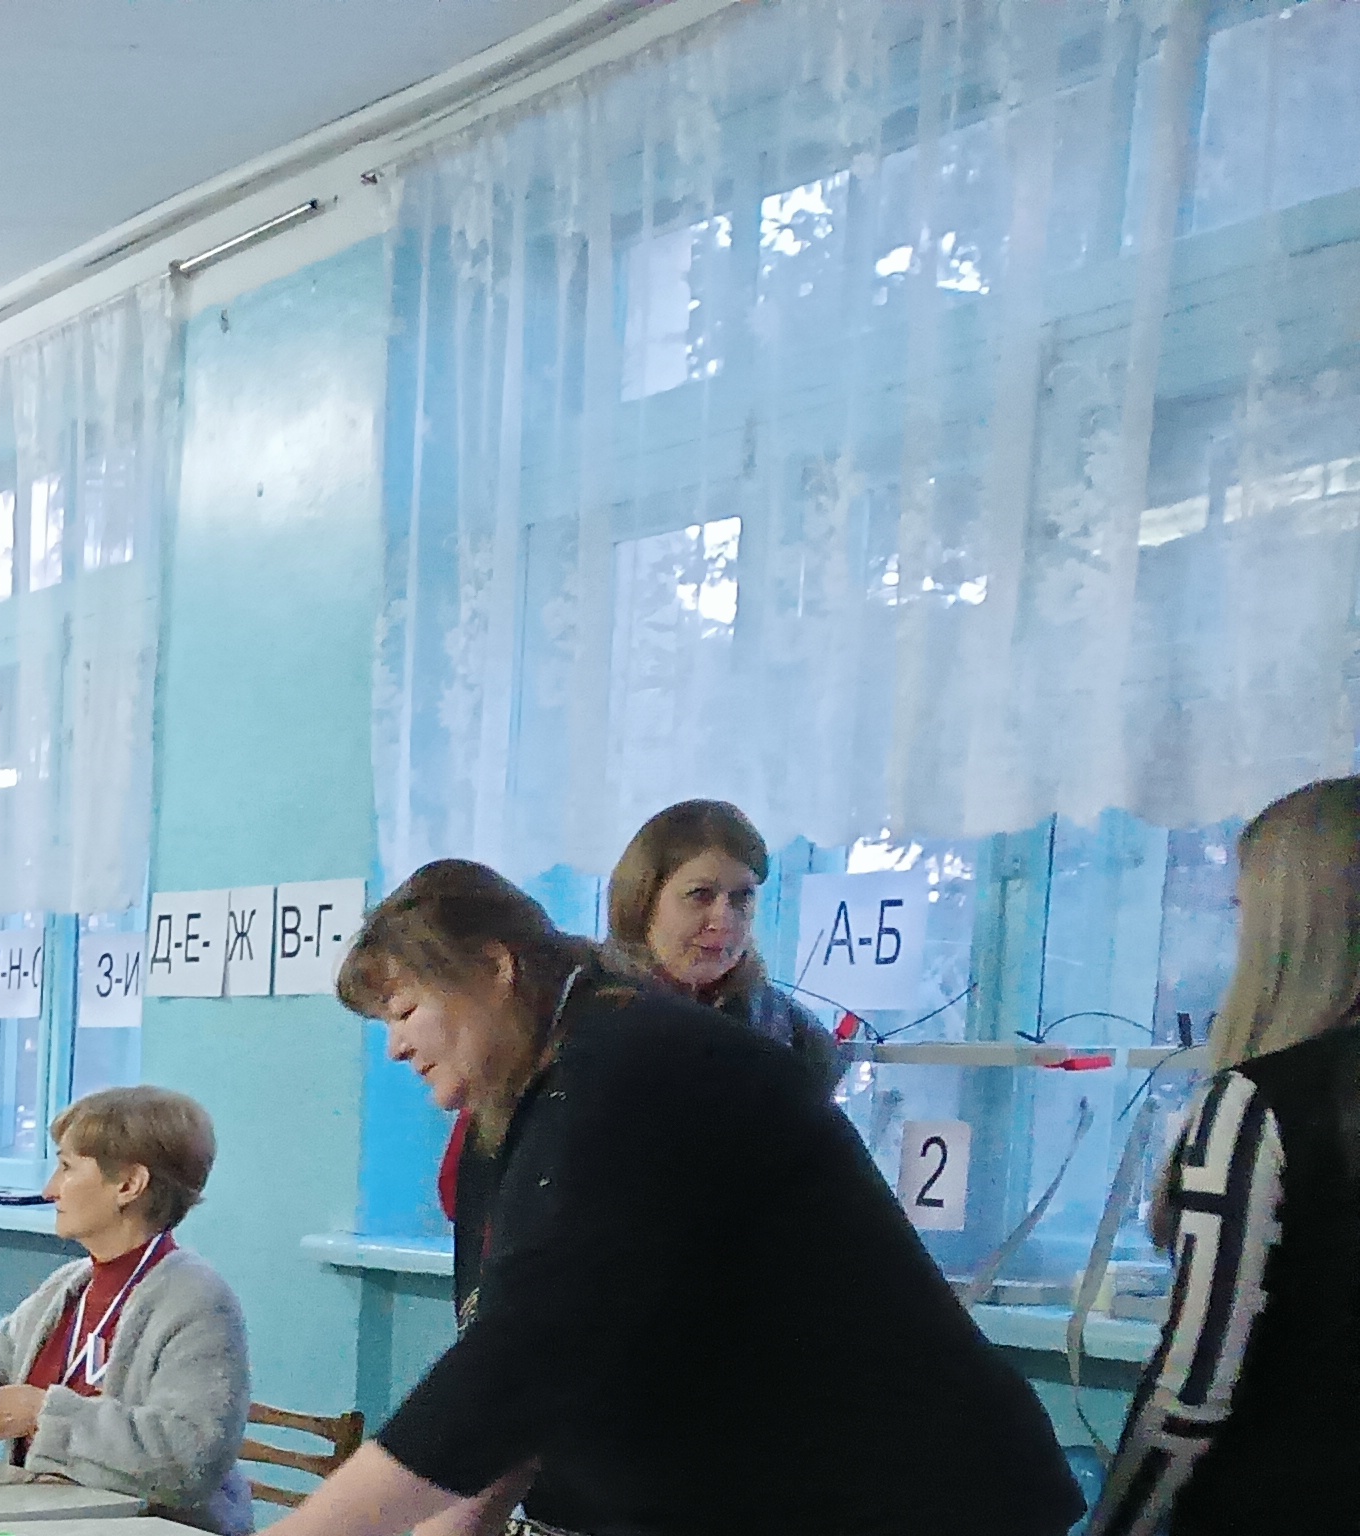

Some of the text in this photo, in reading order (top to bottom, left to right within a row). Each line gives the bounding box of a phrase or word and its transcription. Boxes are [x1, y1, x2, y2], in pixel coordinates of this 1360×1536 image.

[822, 899, 904, 966] А-Б
[95, 951, 141, 998] З-И
[915, 1135, 949, 1208] 2
